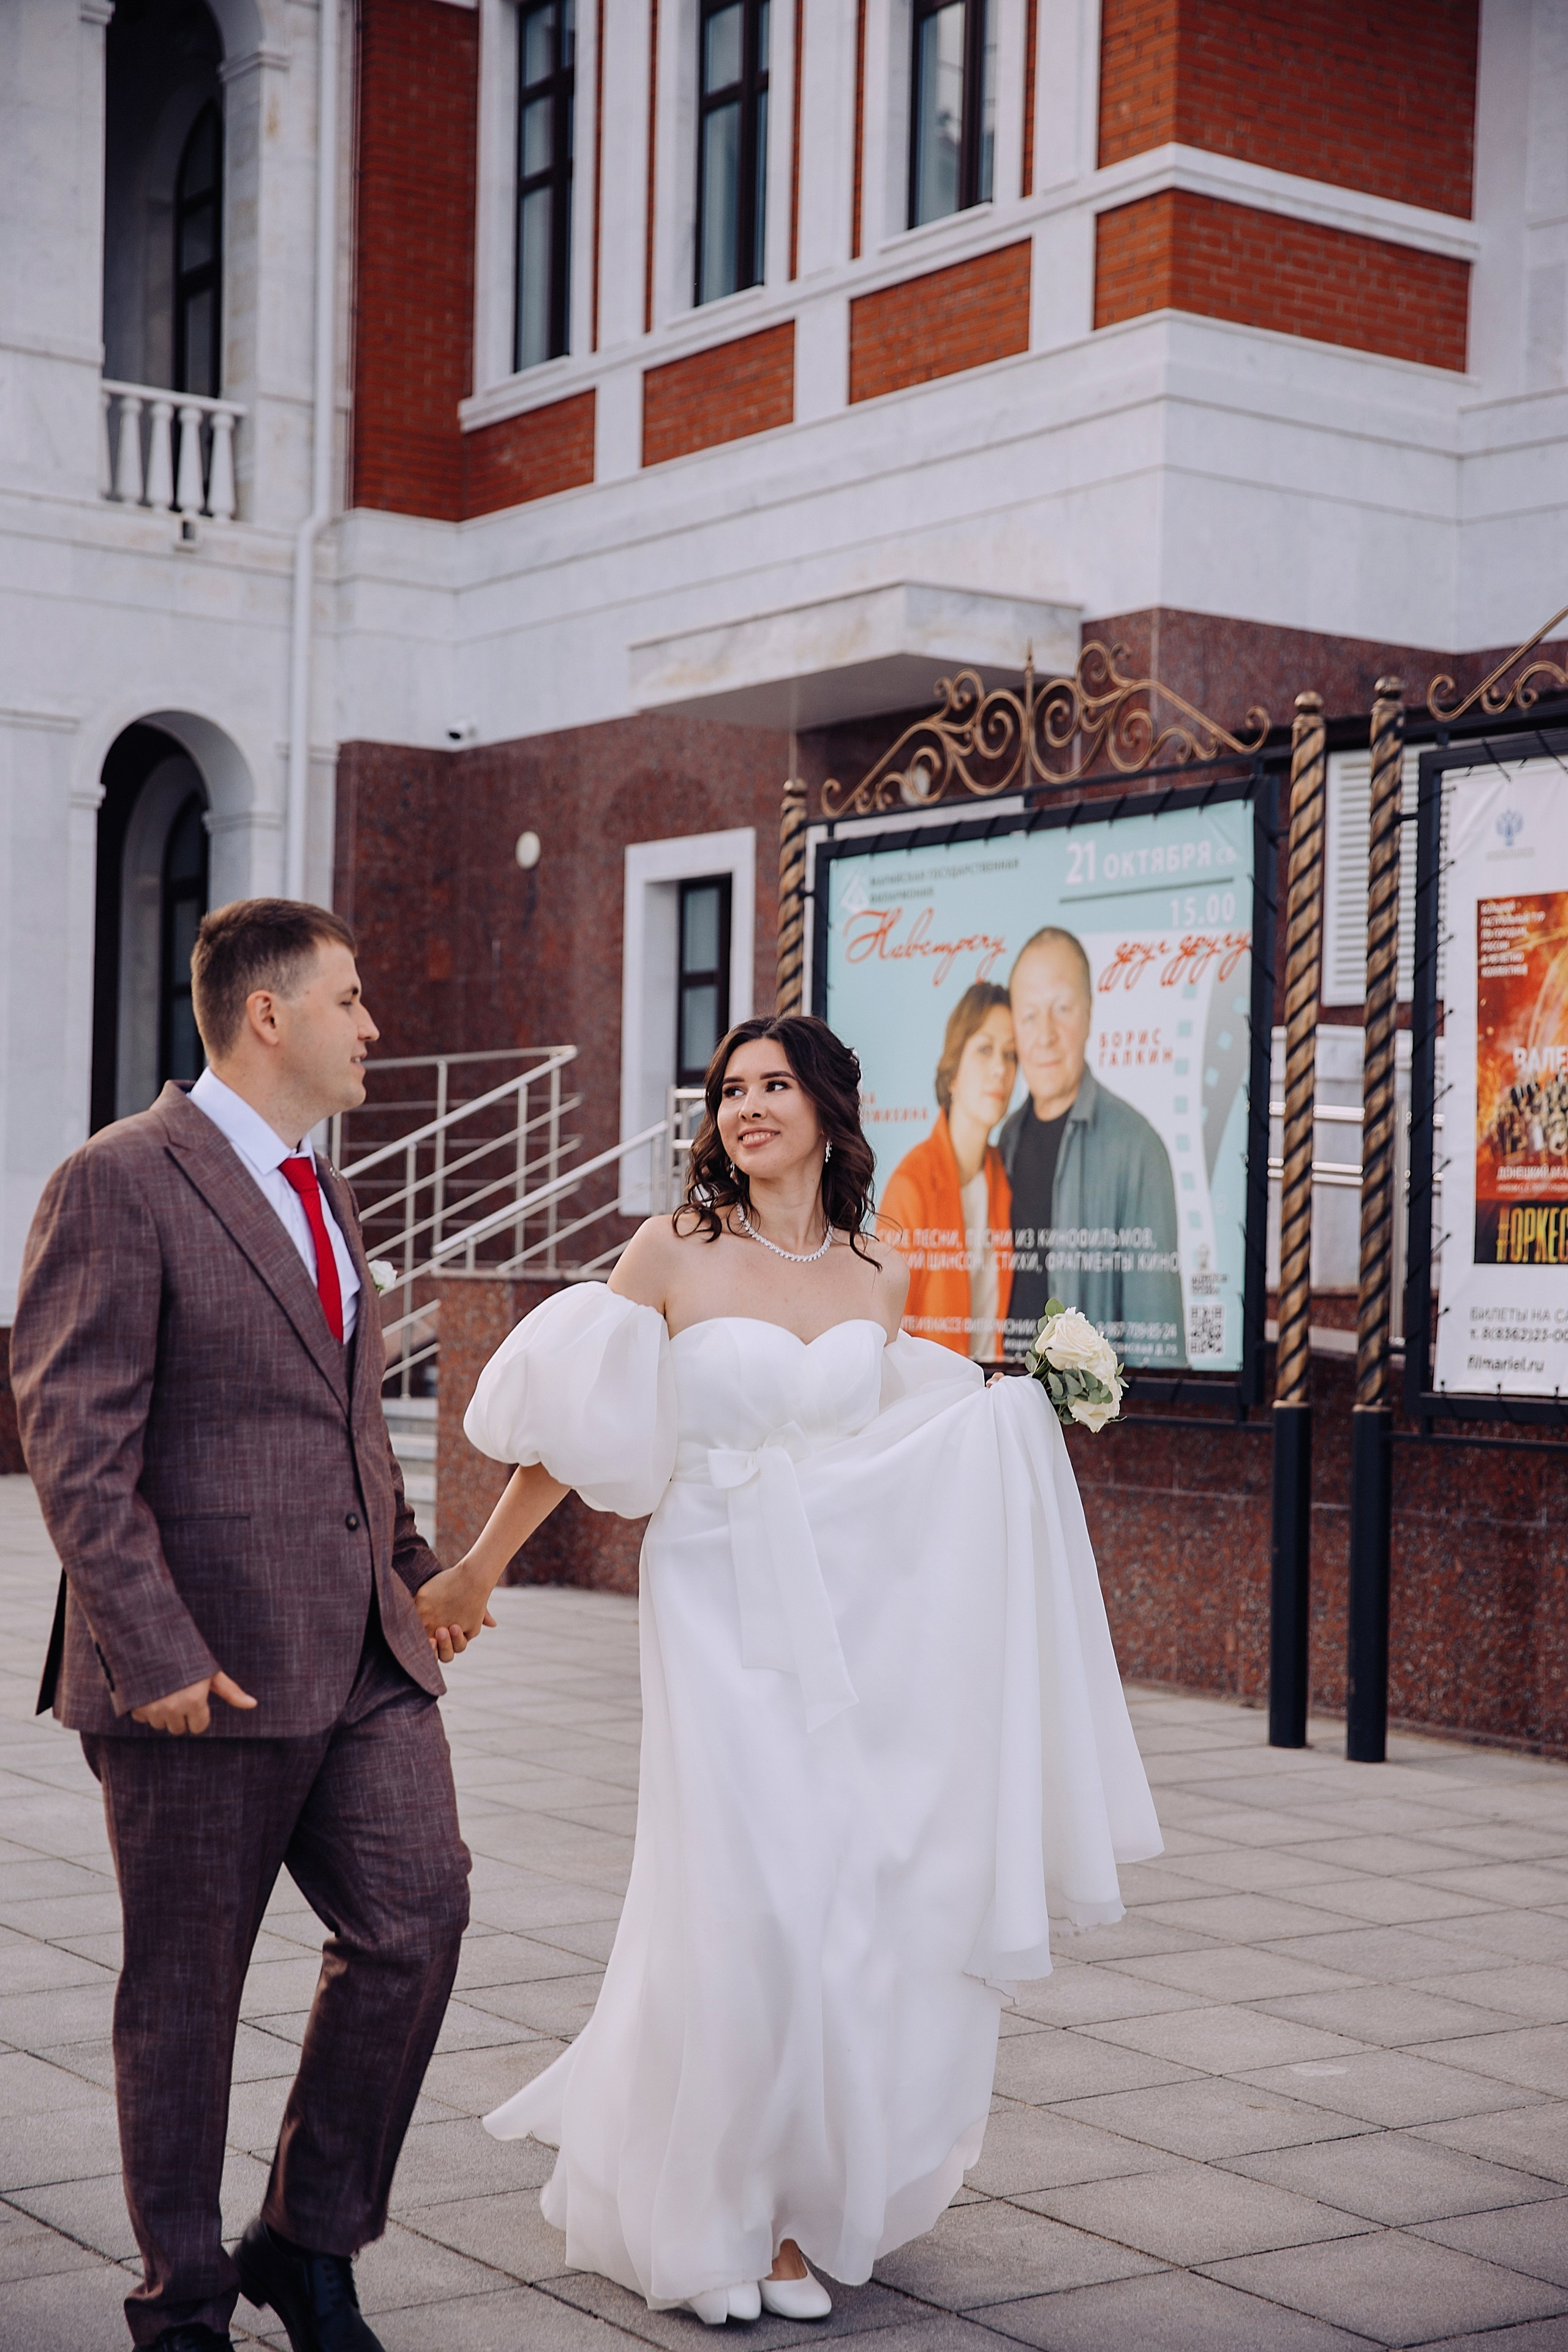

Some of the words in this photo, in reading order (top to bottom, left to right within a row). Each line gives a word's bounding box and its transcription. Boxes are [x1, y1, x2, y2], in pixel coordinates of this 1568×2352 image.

[1066, 840, 1096, 885] 21
[1103, 840, 1212, 881] ОКТЯБРЯ
[1170, 892, 1235, 928] 15.00
[1099, 1028, 1161, 1049] БОРИС
[1099, 1047, 1174, 1066] ГАЛКИН
[913, 1227, 963, 1249] ПЕСНИ,
[965, 1228, 1012, 1248] ПЕСНИ
[1014, 1227, 1035, 1249] ИЗ
[1037, 1227, 1157, 1250] КИНОФИЛЬМОВ,
[990, 1251, 1042, 1274] СТИХИ,
[1045, 1251, 1133, 1273] ФРАГМЕНТЫ
[1137, 1251, 1179, 1273] КИНО
[1471, 1306, 1528, 1322] БИЛЕТЫ
[1531, 1308, 1551, 1322] НА
[1468, 1355, 1544, 1372] filmariel.ru
